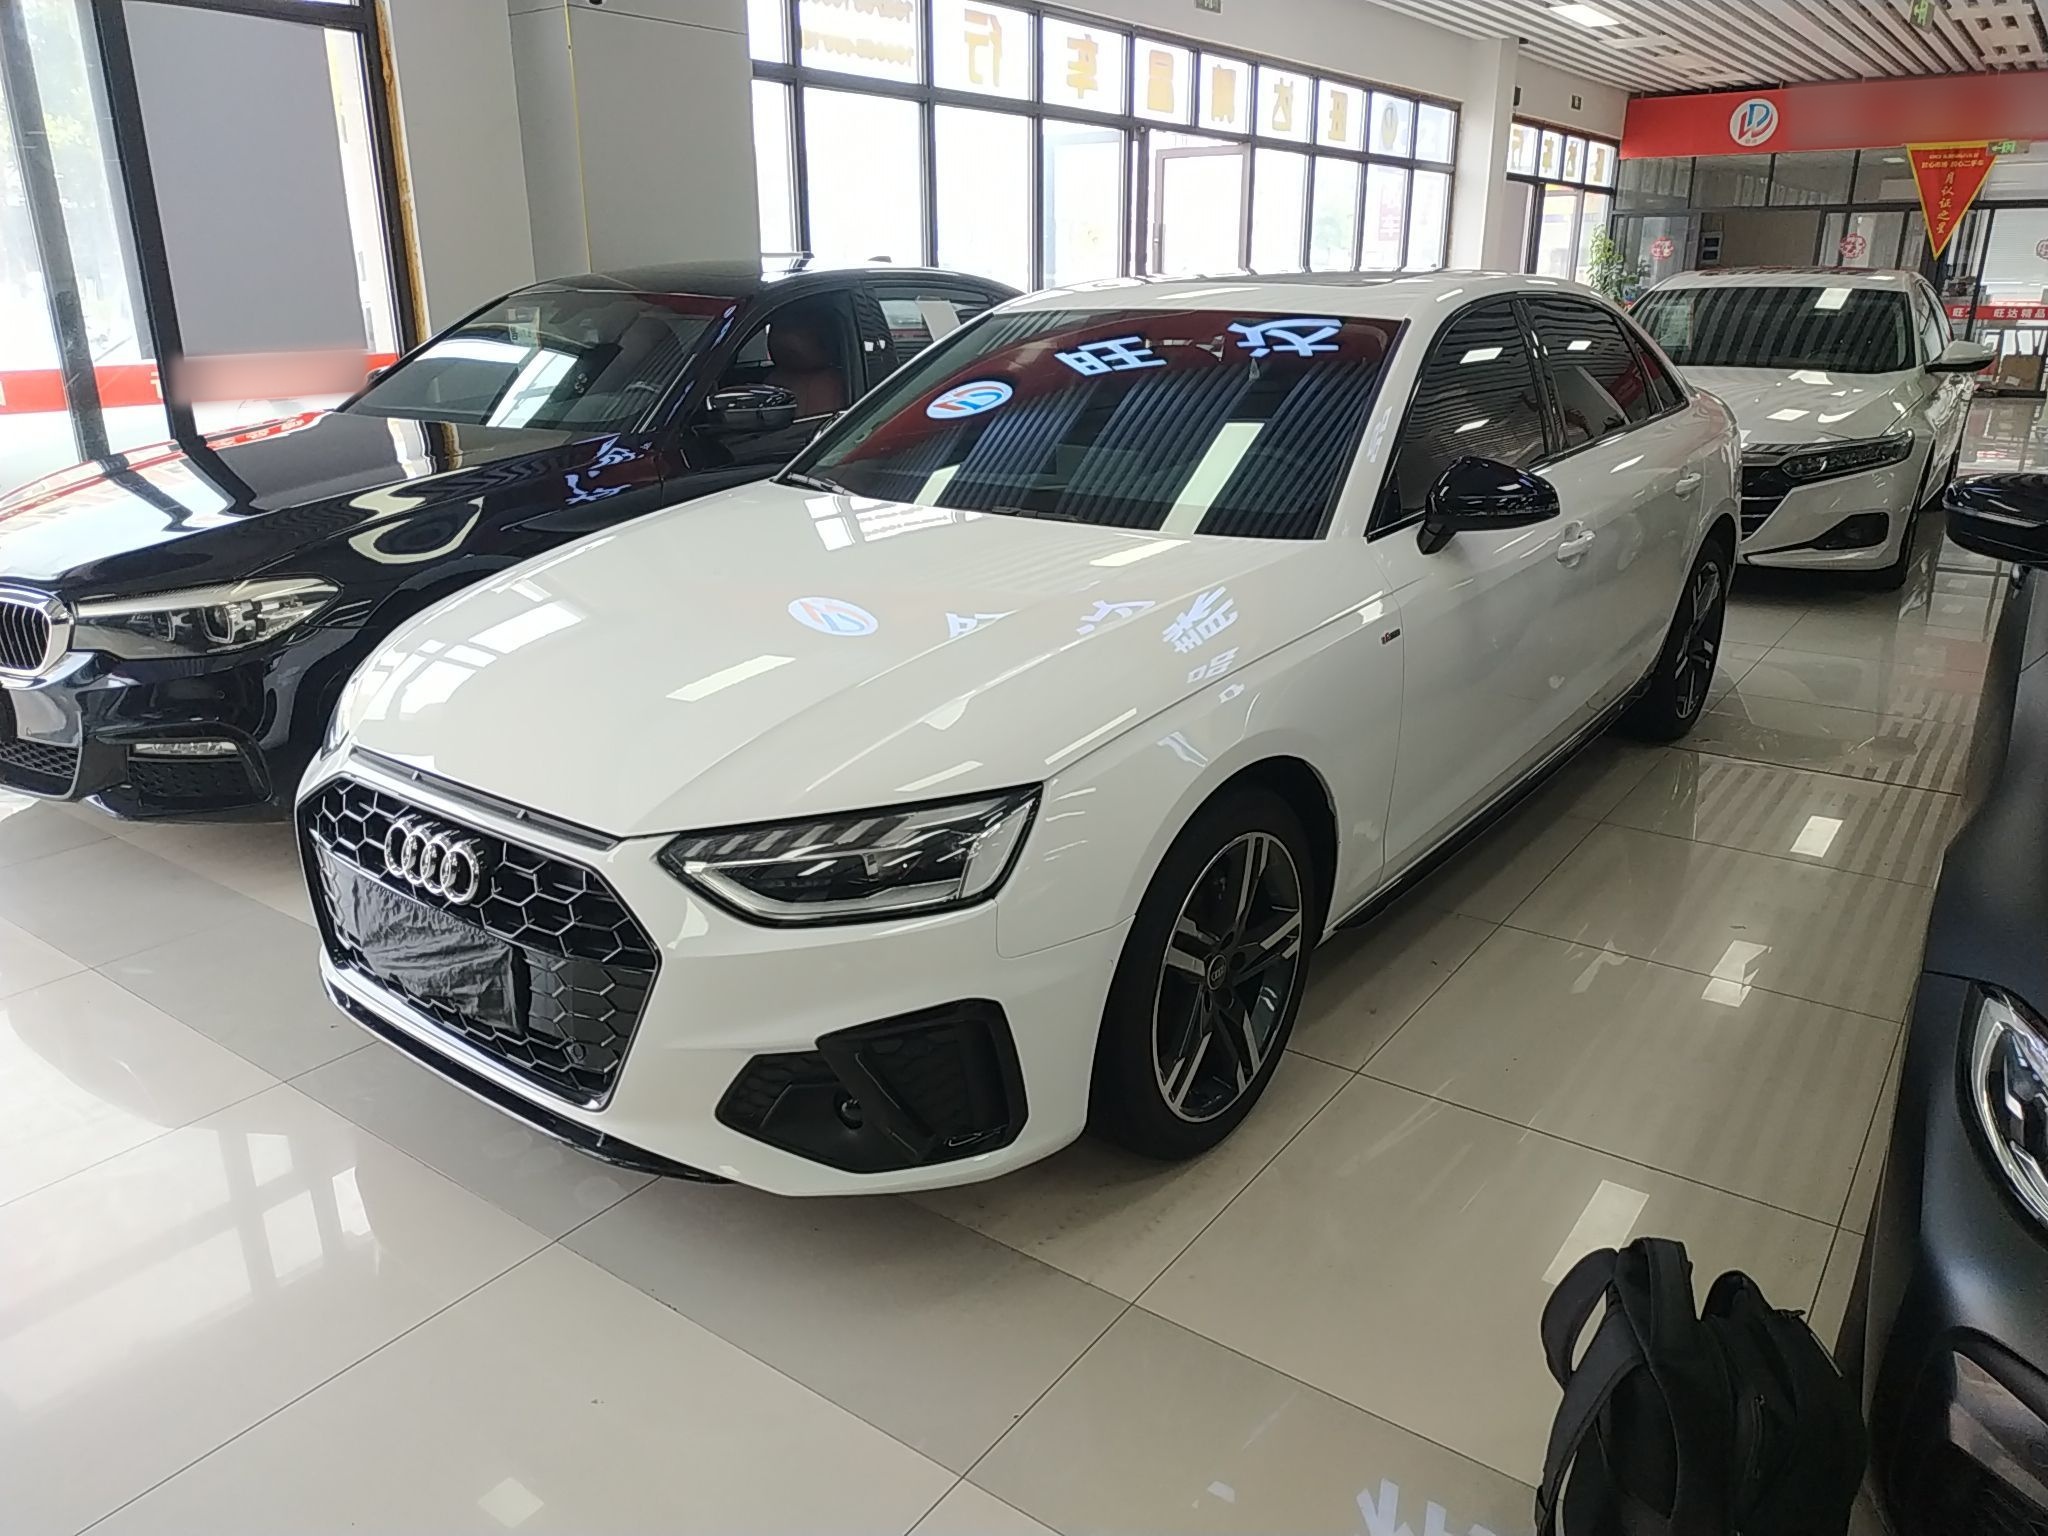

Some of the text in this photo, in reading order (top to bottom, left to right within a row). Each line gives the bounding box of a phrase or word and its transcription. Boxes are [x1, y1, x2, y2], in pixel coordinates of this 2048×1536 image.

[1936, 171, 1955, 234] 月认证之星
